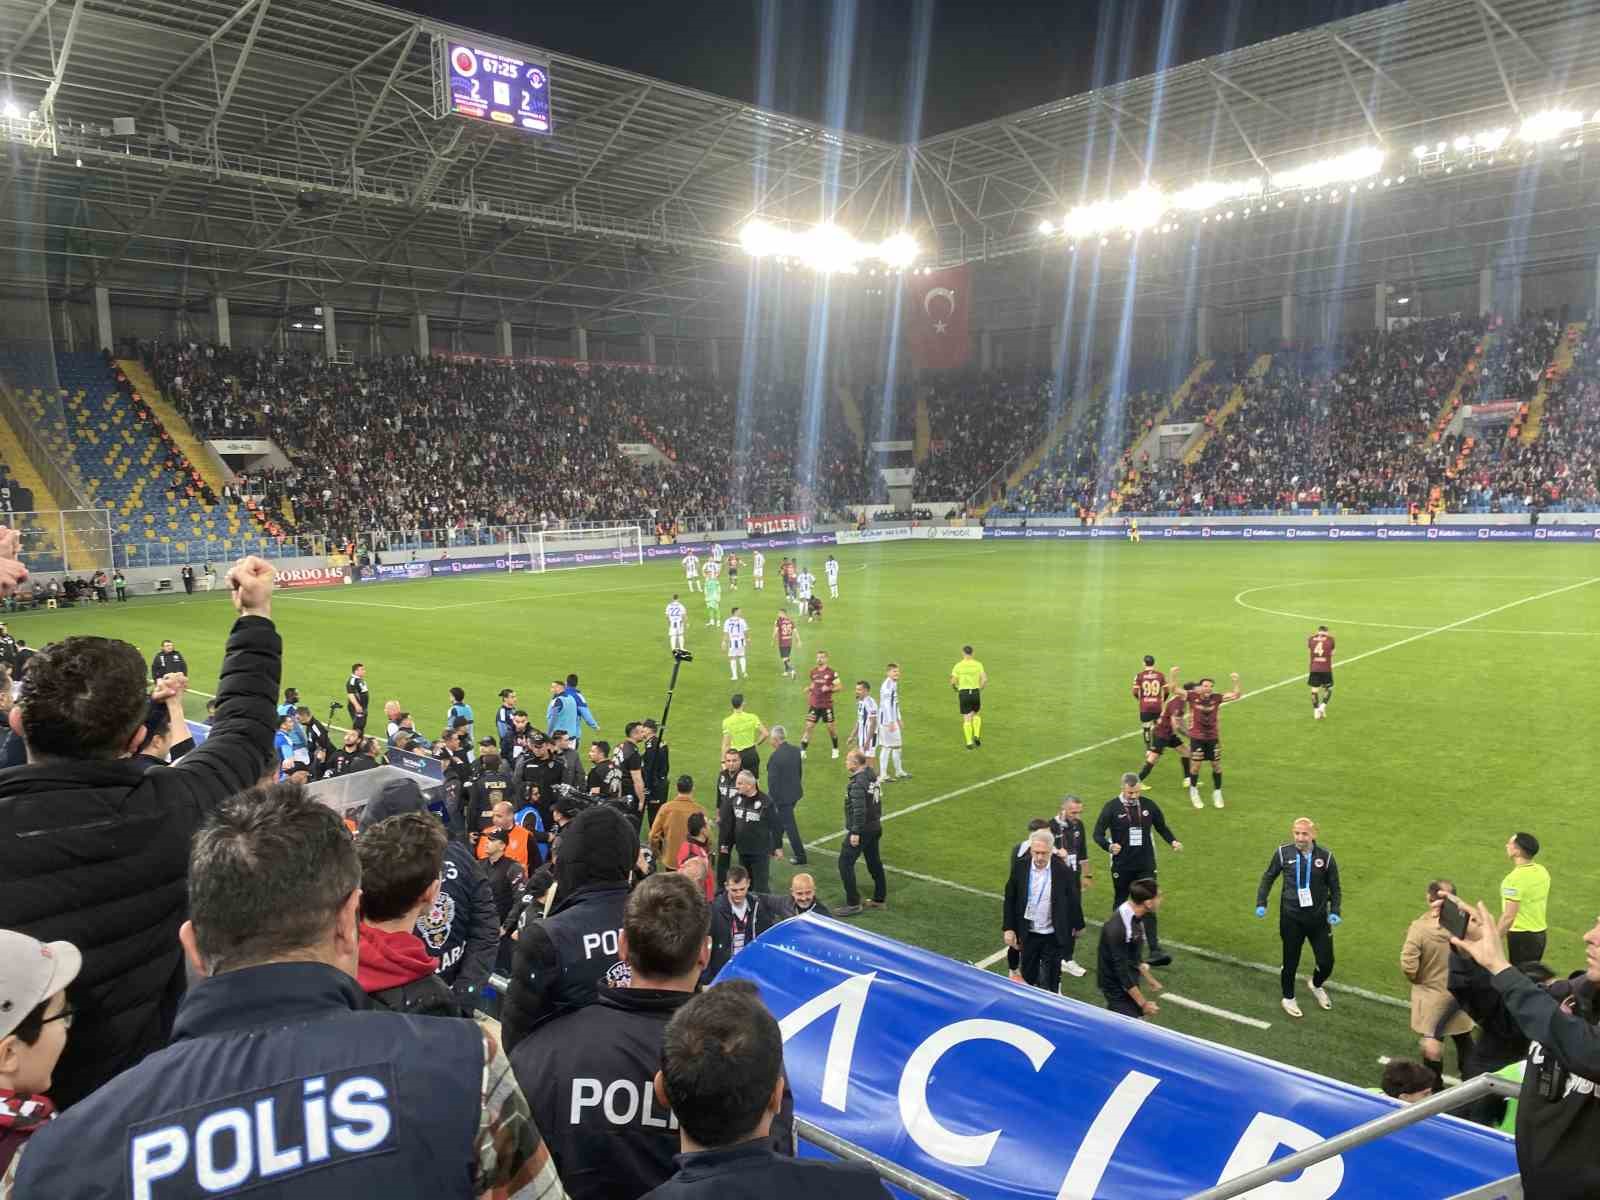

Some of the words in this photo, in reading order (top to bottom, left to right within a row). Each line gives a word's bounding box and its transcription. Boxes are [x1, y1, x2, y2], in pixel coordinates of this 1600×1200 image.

[482, 58, 518, 79] 67:25
[470, 78, 481, 99] 2
[521, 90, 531, 111] 2
[670, 607, 681, 617] 22
[728, 622, 741, 633] 71
[1313, 641, 1325, 657] 4
[1142, 680, 1161, 697] 99
[583, 928, 624, 959] PO
